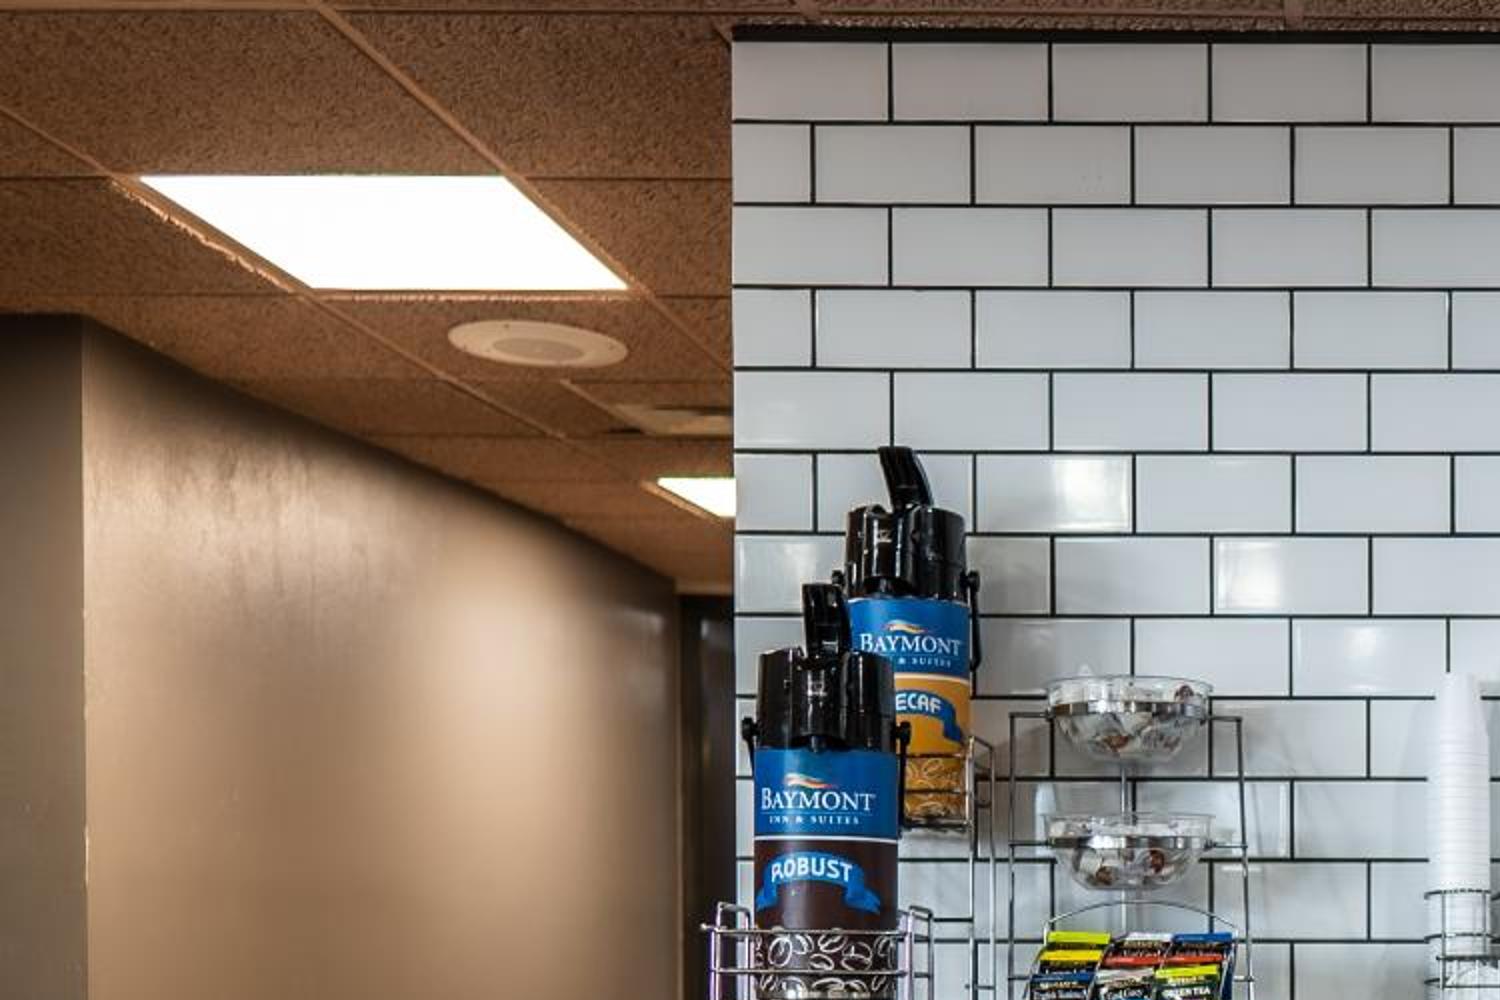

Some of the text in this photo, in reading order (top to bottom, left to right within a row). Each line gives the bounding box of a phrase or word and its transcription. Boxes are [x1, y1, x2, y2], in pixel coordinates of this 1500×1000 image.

[860, 632, 960, 656] BAYMONT
[895, 691, 941, 713] ECAF
[761, 787, 876, 811] BAYMONT
[769, 815, 789, 824] INN
[811, 815, 859, 825] SUITES
[771, 856, 852, 883] ROBUST
